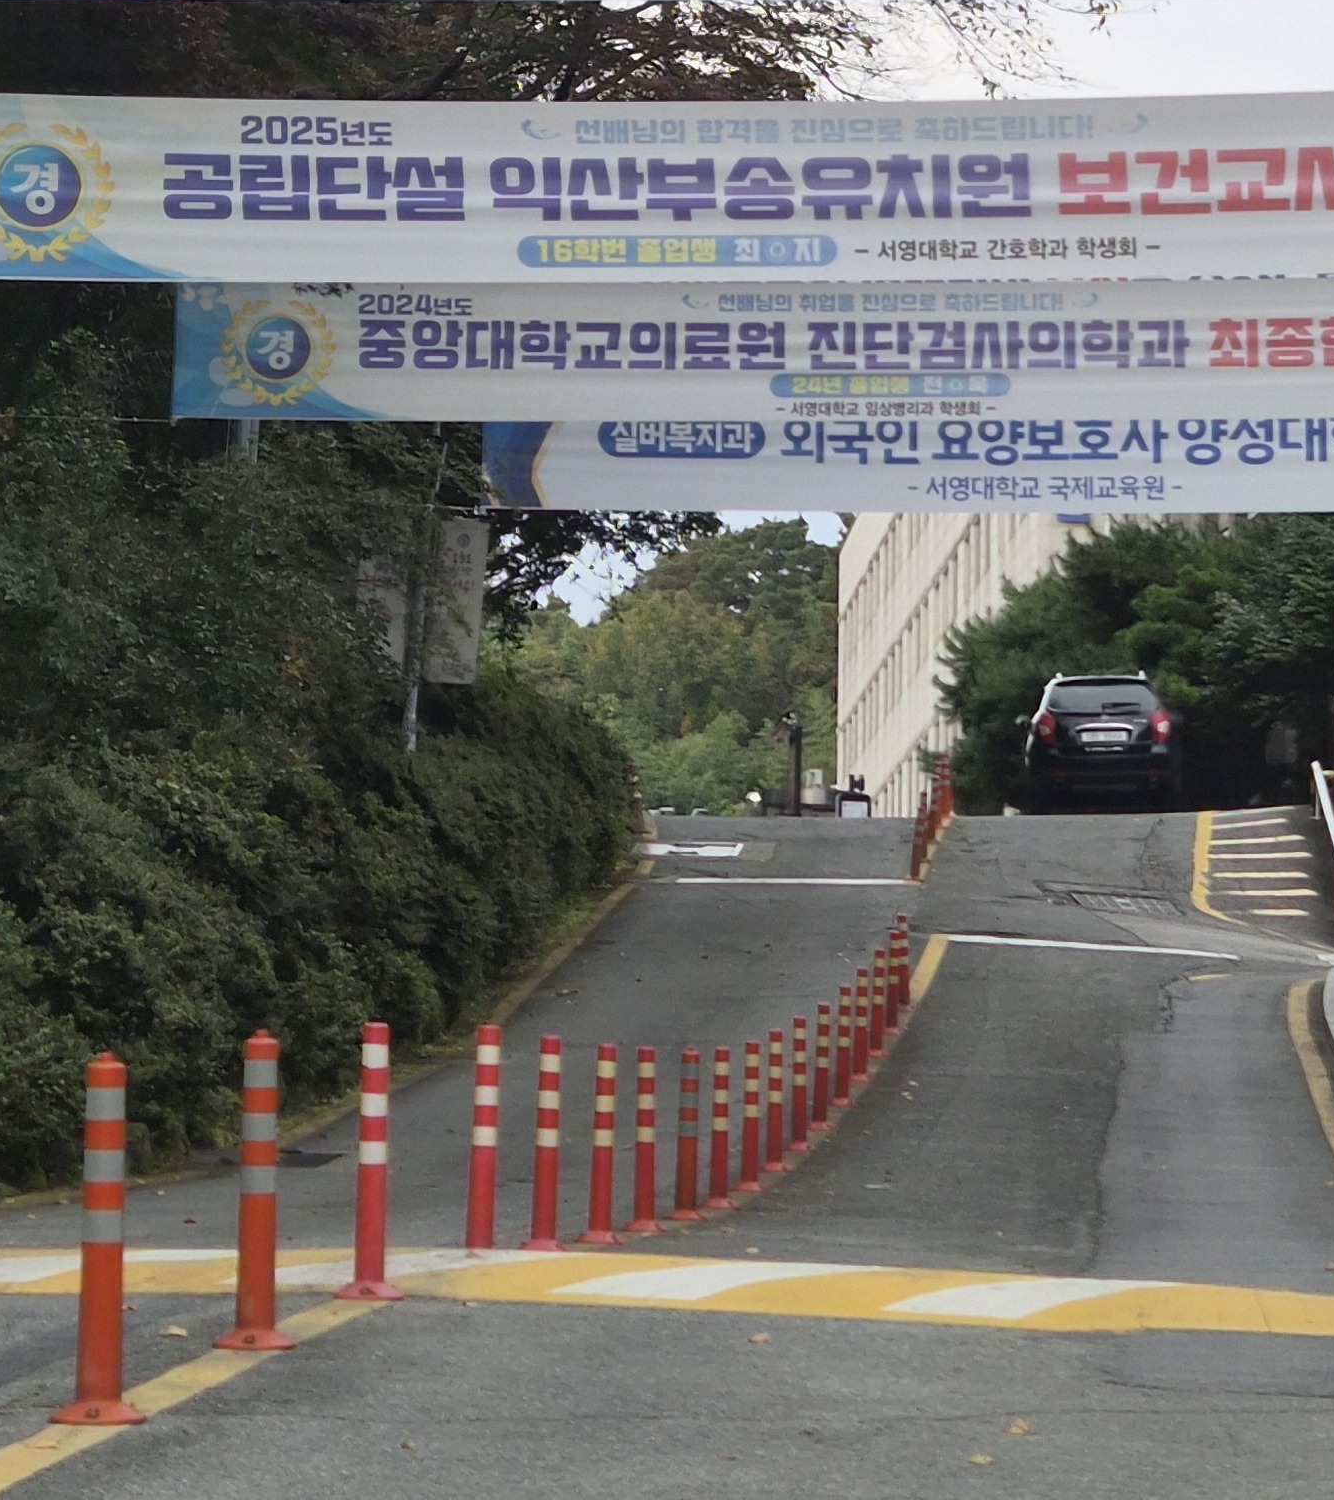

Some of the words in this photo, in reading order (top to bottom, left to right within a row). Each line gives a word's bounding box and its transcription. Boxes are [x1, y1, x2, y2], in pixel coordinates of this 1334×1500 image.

[240, 115, 392, 146] 2025년도
[575, 119, 685, 144] 선배님의
[697, 118, 779, 143] 합격을
[791, 117, 902, 143] 진심으로
[915, 115, 1094, 141] 축하드립니다!
[9, 162, 60, 215] 경
[163, 153, 466, 221] 공립단설
[489, 153, 1032, 222] 익산부송유치원
[536, 239, 627, 263] 16학번
[877, 239, 978, 261] 서영대학교
[987, 238, 1068, 260] 간호학과
[1076, 237, 1137, 259] 학생회
[359, 294, 472, 316] 2024년도
[258, 330, 296, 370] 경
[359, 319, 785, 370] 중앙대학교의료원
[807, 319, 1190, 370] 진단검사의학과
[610, 421, 755, 453] 실버복지과
[781, 421, 920, 464] 외국인
[932, 420, 1168, 465] 요양보호사
[926, 476, 1040, 500] 서영대학교
[1048, 476, 1164, 500] 국제교육원
